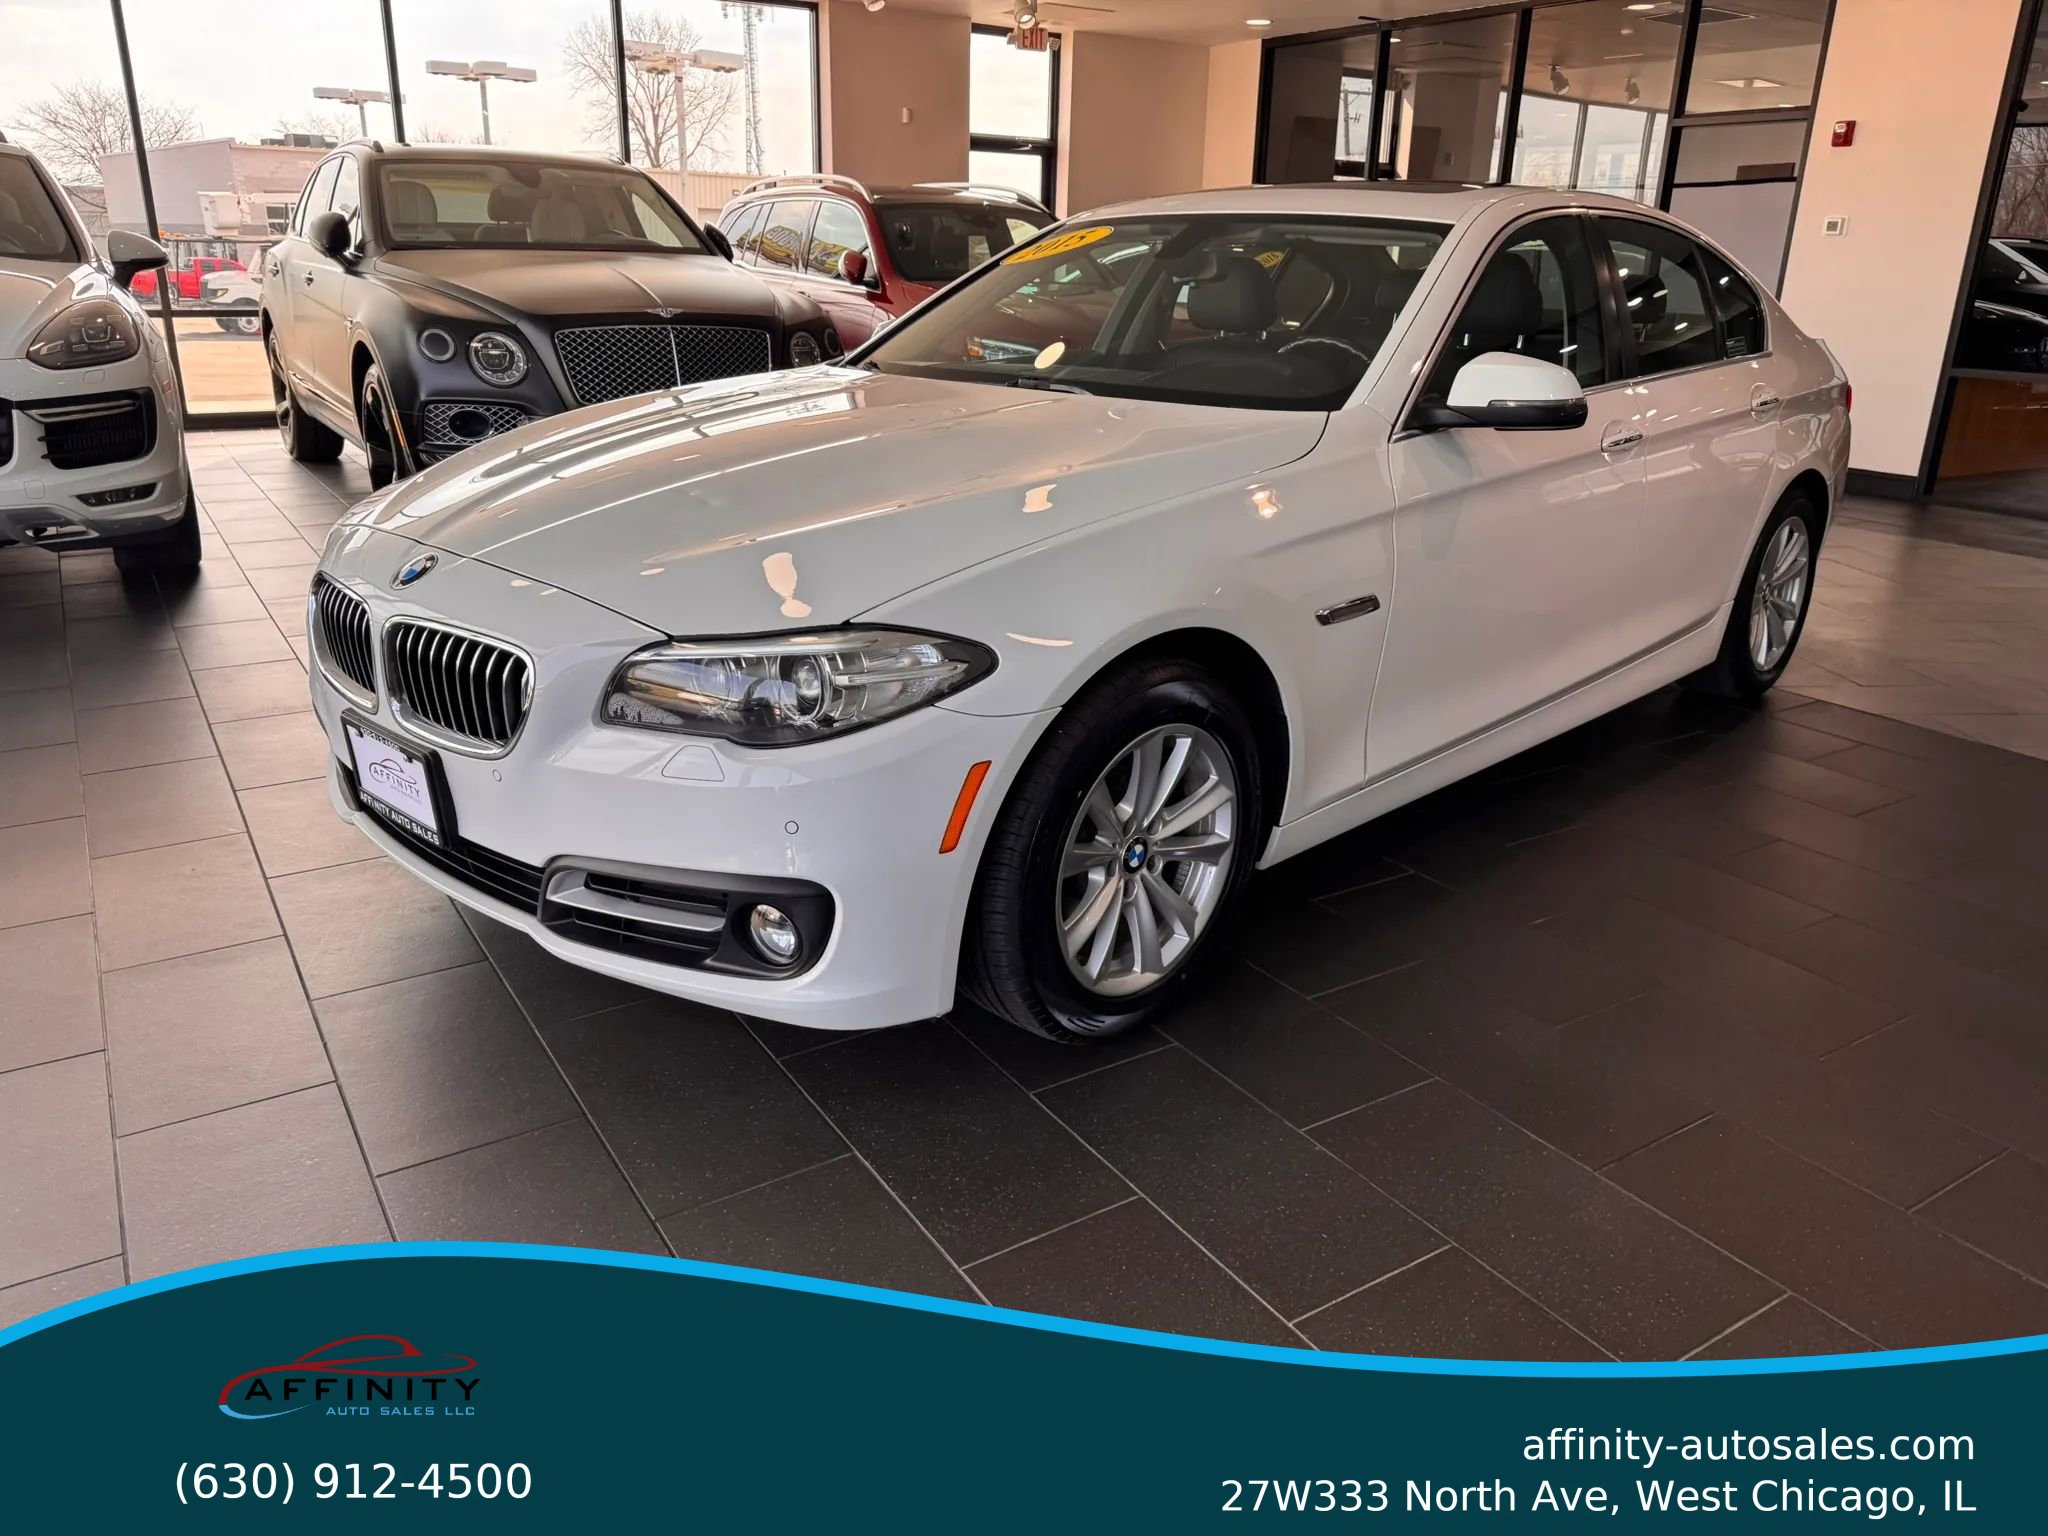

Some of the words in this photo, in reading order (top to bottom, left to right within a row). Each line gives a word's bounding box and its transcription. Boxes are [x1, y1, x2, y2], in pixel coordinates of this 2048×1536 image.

[1022, 28, 1045, 49] EXIT
[373, 766, 420, 798] AFFINITY
[360, 791, 390, 816] AFFINITY
[391, 810, 410, 829] AUTO
[411, 822, 440, 845] SALES
